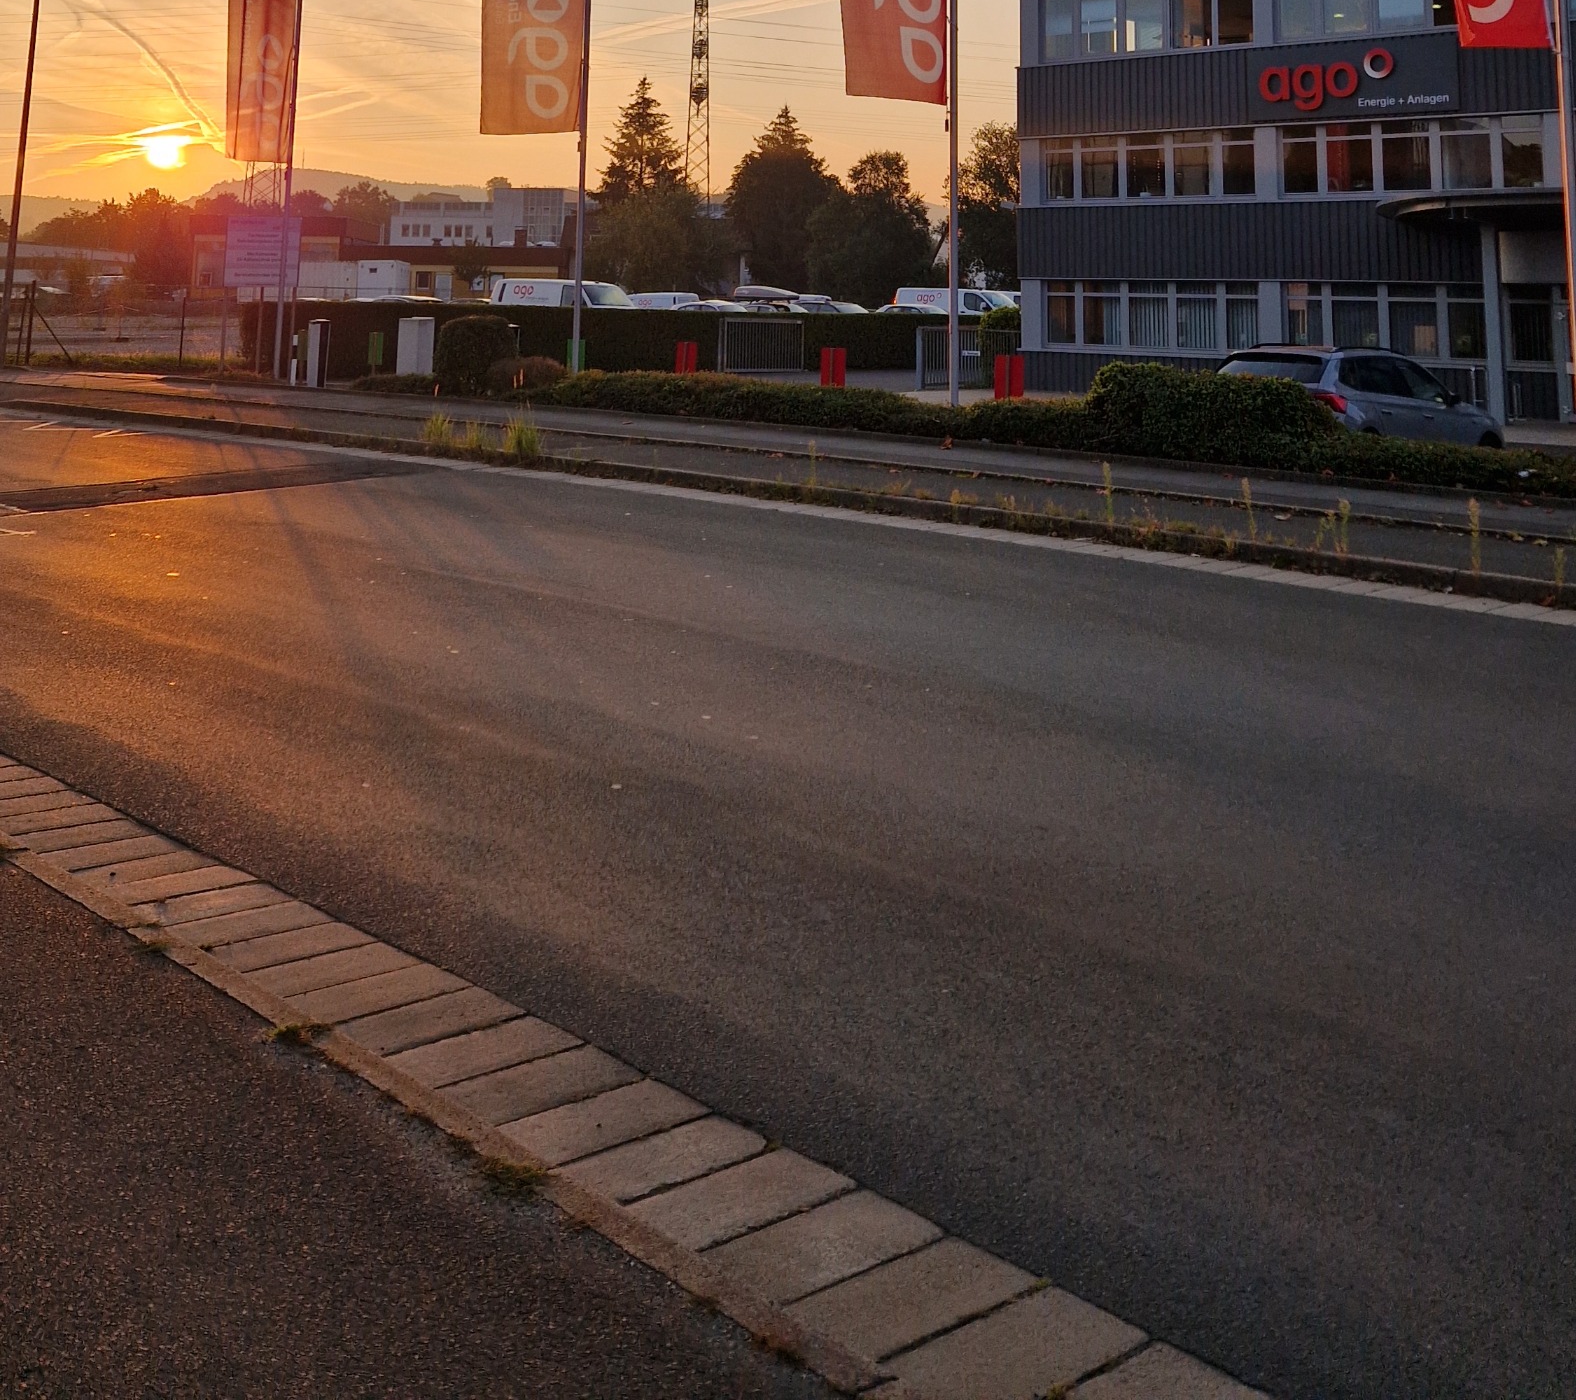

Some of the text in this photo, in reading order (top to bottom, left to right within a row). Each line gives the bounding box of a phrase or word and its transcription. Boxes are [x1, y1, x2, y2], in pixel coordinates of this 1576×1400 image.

[1259, 62, 1358, 110] ago
[1358, 96, 1396, 107] Energie
[1407, 93, 1449, 106] Anlagen
[513, 285, 534, 299] ago
[916, 294, 936, 304] ago
